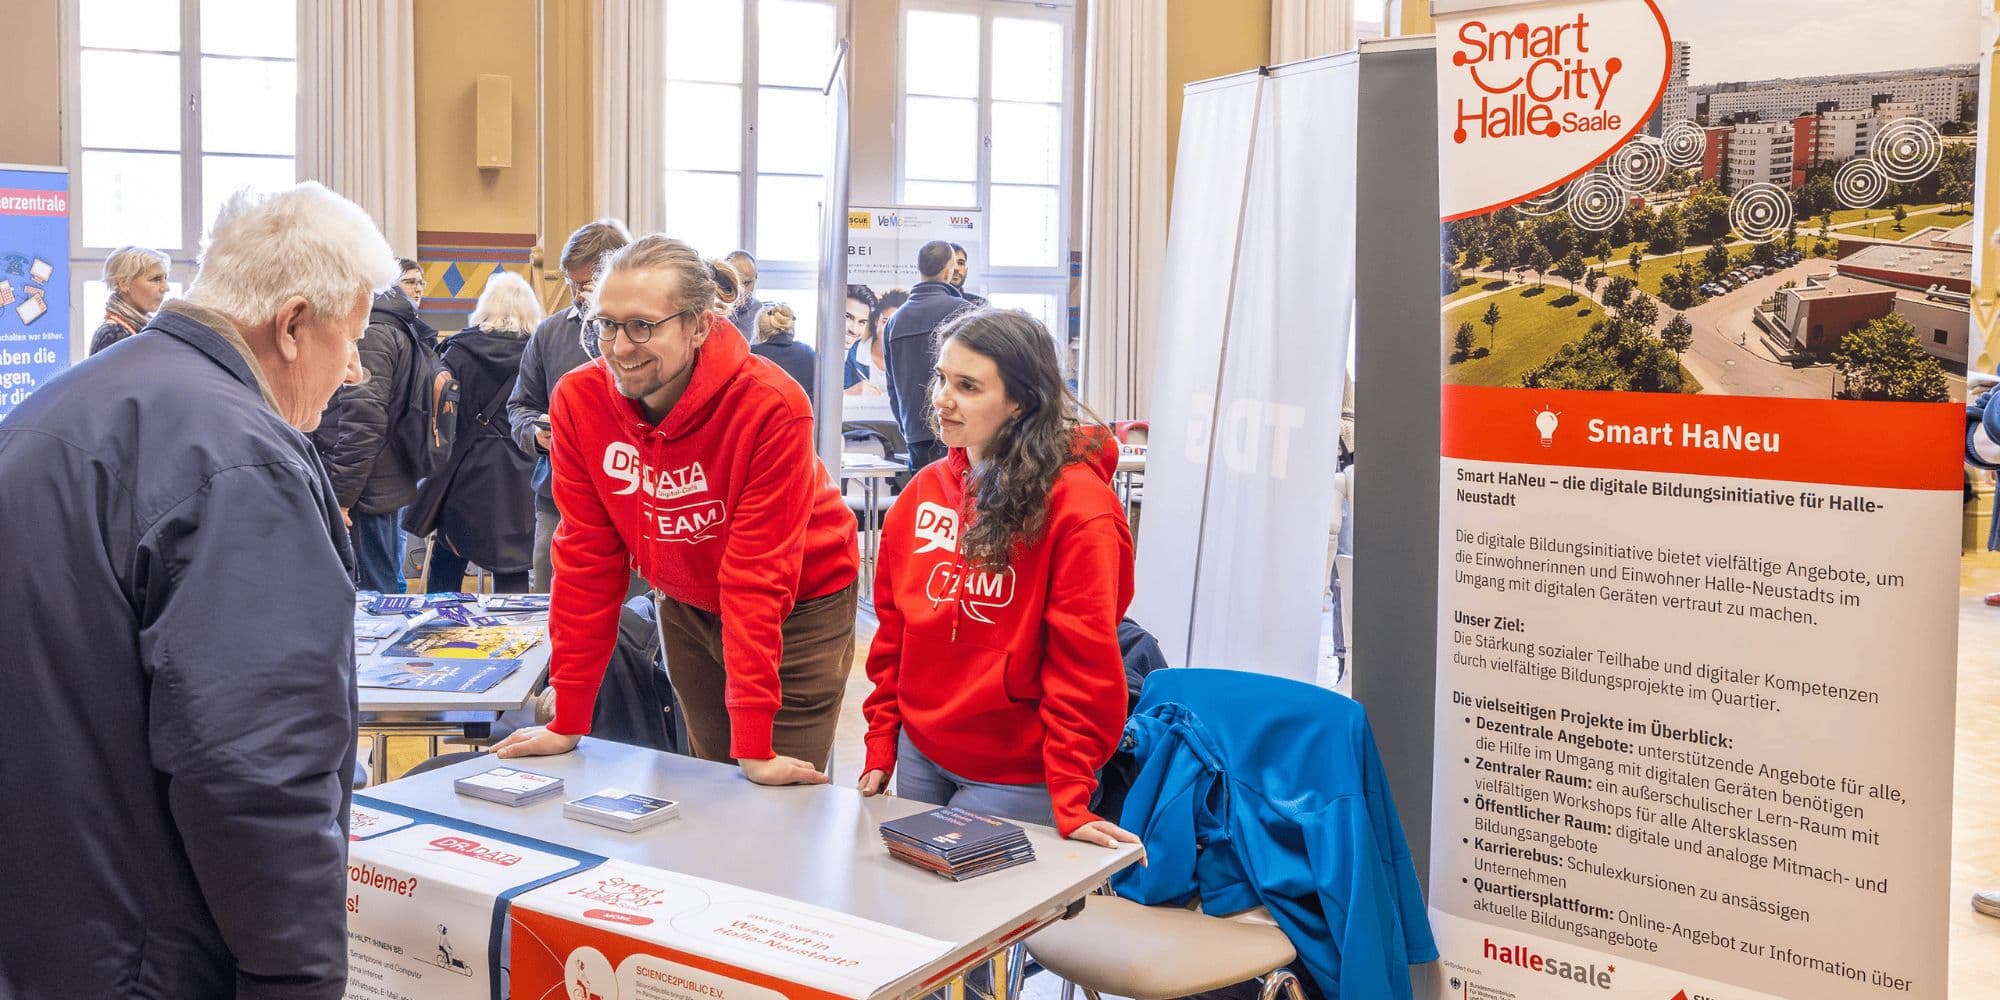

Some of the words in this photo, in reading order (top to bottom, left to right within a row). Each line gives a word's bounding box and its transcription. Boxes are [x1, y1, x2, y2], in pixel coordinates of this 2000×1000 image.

[1453, 13, 1590, 66] Smart
[1526, 57, 1622, 110] City
[1453, 93, 1561, 144] Halle
[1562, 110, 1621, 133] Saale
[0, 194, 65, 212] erzentrale
[0, 371, 36, 389] gen,
[34, 347, 56, 365] die
[1587, 418, 1673, 446] Smart
[1682, 422, 1780, 453] HaNeu
[1457, 468, 1495, 486] Smart
[1498, 472, 1545, 487] HaNeu
[1563, 475, 1587, 490] die
[1590, 477, 1648, 496] digitale
[1652, 482, 1795, 506] Bildungsinitiative
[1799, 492, 1824, 509] für
[1829, 495, 1883, 512] Halle-
[1457, 486, 1516, 506] Neustadt
[917, 509, 956, 541] DR.
[1456, 529, 1475, 544] Die
[1477, 531, 1525, 552] digitale
[1529, 536, 1653, 561] Bildungsinitiative
[1658, 547, 1702, 568] bietet
[1704, 553, 1782, 579] vielfältige
[1786, 562, 1870, 586] Angebote,
[1877, 574, 1903, 587] um
[1456, 548, 1472, 566] die
[1474, 549, 1585, 578] Einwohnerinnen
[1590, 565, 1618, 580] und
[1622, 567, 1701, 591] Einwohner
[1704, 574, 1835, 604] Halle-Neustadts
[1840, 588, 1860, 607] im
[1455, 610, 1491, 630] Unser
[1493, 616, 1524, 632] Ziel:
[1456, 569, 1505, 592] Umgang
[1507, 573, 1531, 591] mit
[1534, 577, 1596, 599] digitalen
[1600, 584, 1657, 606] Geräten
[1662, 592, 1723, 613] vertraut
[1726, 602, 1744, 616] zu
[1748, 601, 1817, 625] machen.
[1454, 629, 1473, 647] Die
[1474, 629, 1536, 658] Stärkung
[1537, 645, 1594, 662] sozialer
[1597, 650, 1661, 673] Teilhabe
[1664, 662, 1692, 677] und
[1697, 664, 1760, 687] digitaler
[1765, 673, 1878, 704] Kompetenzen
[1454, 650, 1488, 669] durch
[1489, 652, 1558, 680] vielfältige
[1560, 664, 1685, 696] Bildungsprojekte
[1689, 684, 1708, 701] im
[1710, 686, 1780, 712] Quartier.
[1453, 690, 1472, 706] Die
[1475, 696, 1556, 722] vielseitigen
[1560, 708, 1624, 734] Projekte
[1628, 718, 1646, 735] im
[1651, 720, 1733, 749] Überblick:
[1476, 736, 1496, 752] die
[1498, 738, 1532, 760] Hilfe
[1534, 744, 1552, 761] im
[1556, 747, 1615, 777] Umgang
[1617, 760, 1642, 781] mit
[1644, 764, 1711, 795] digitalen
[1713, 776, 1778, 805] Geräten
[1781, 788, 1863, 820] benötigen
[1477, 713, 1554, 741] Dezentrale
[1556, 726, 1635, 754] Angebote:
[1638, 744, 1754, 777] unterstützende
[1758, 763, 1837, 793] Angebote
[1840, 778, 1864, 796] für
[1869, 784, 1905, 805] alle,
[1475, 777, 1550, 806] vielfältigen
[1553, 789, 1633, 824] Workshops
[1635, 804, 1658, 827] für
[1659, 811, 1688, 831] alle
[1689, 815, 1797, 852] Altersklassen
[1476, 756, 1541, 781] Zentraler
[1544, 768, 1593, 792] Raum:
[1595, 776, 1619, 797] ein
[1621, 783, 1753, 822] außerschulischer
[1756, 808, 1846, 839] Lern-Raum
[1852, 829, 1880, 845] mit
[1475, 816, 1598, 854] Bildungsangebote
[1475, 793, 1562, 824] Öffentlicher
[1563, 814, 1612, 836] Raum:
[1616, 823, 1671, 847] digitale
[1674, 836, 1703, 856] und
[1705, 840, 1769, 870] analoge
[1773, 856, 1850, 884] Mitmach-
[1856, 877, 1887, 893] und
[1475, 854, 1566, 888] Unternehmen
[1475, 837, 1563, 867] Karrierebus:
[1567, 856, 1695, 896] Schulexkursionen
[1700, 888, 1717, 901] zu
[1722, 893, 1809, 922] ansässigen
[730, 920, 769, 935] Was
[1473, 897, 1529, 920] aktuelle
[1530, 907, 1658, 952] Bildungsangebote
[1474, 877, 1614, 920] Quartiersplattform:
[1617, 908, 1736, 950] Online-Angebot
[1740, 941, 1765, 956] zur
[1769, 945, 1866, 982] Information
[1872, 970, 1912, 991] über
[636, 965, 709, 995] SCIENCE2PUBLIC
